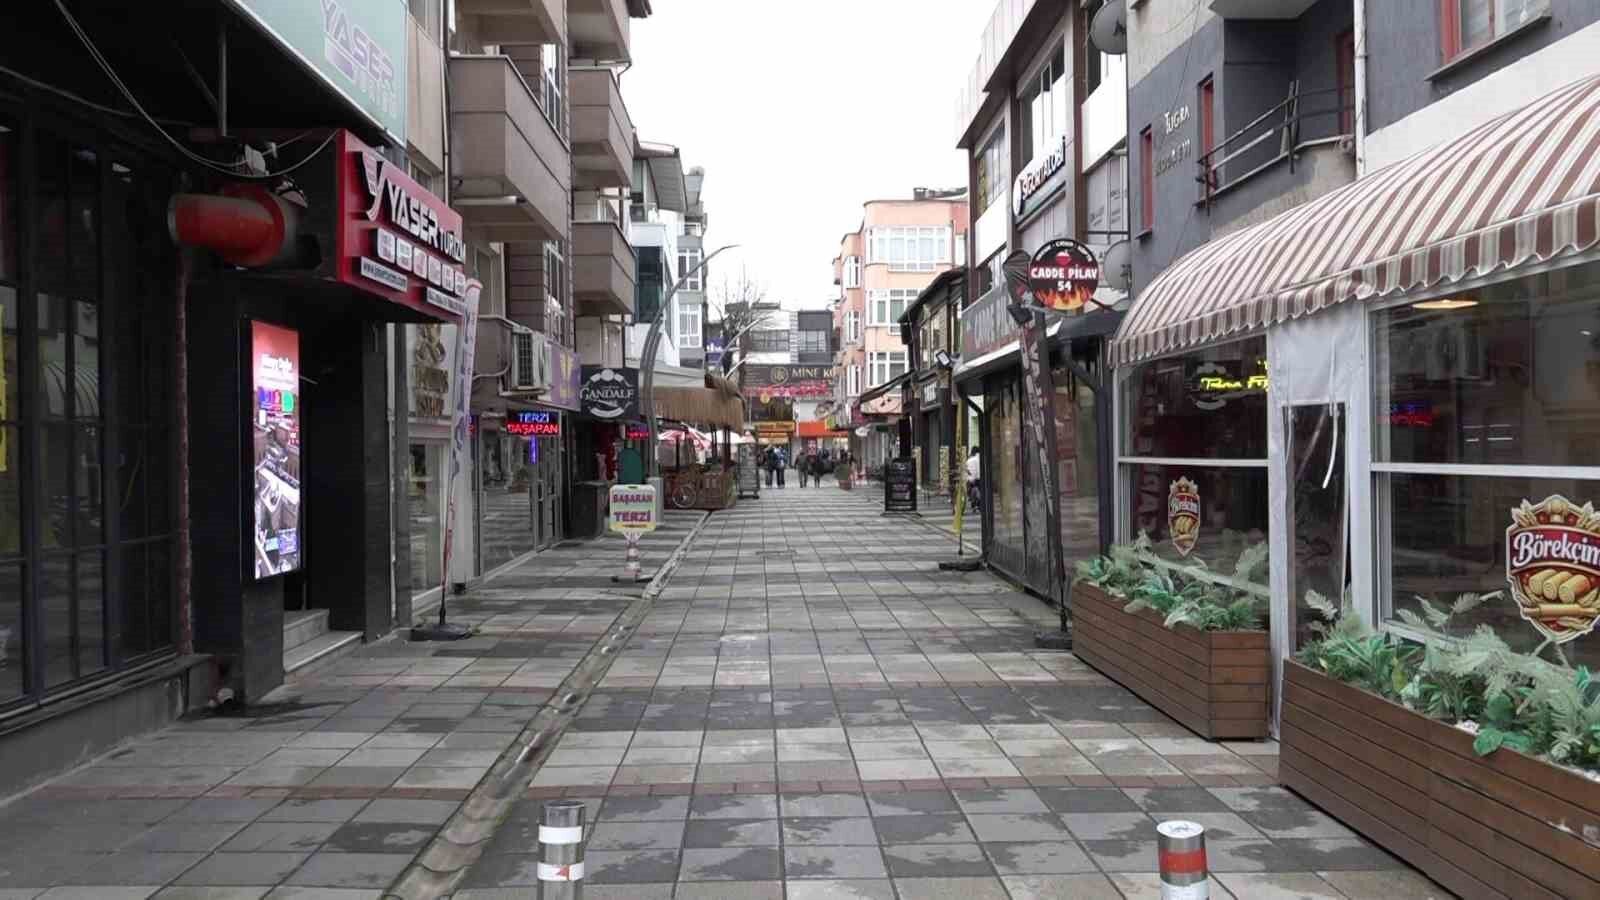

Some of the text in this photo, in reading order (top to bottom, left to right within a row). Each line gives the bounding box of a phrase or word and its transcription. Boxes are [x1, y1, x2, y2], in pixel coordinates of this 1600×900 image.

[320, 0, 394, 81] YASER
[387, 178, 439, 249] YASER
[1031, 263, 1098, 279] CADDE PİLAV
[1057, 281, 1072, 292] 54
[580, 387, 634, 401] GANDALF
[1512, 531, 1600, 567] Börekçim
